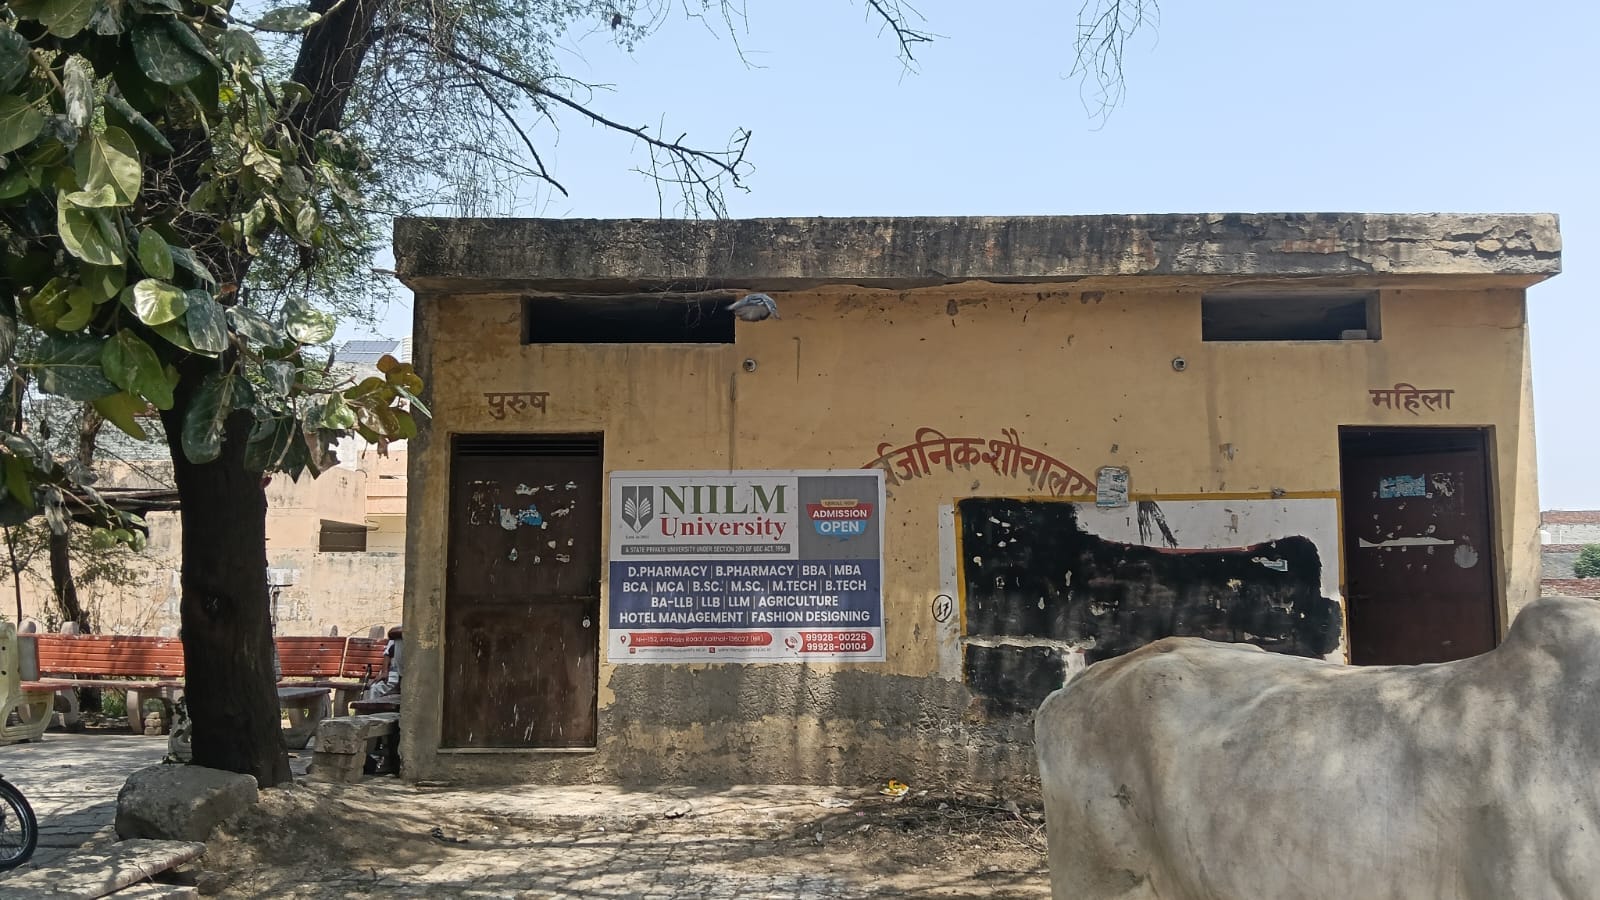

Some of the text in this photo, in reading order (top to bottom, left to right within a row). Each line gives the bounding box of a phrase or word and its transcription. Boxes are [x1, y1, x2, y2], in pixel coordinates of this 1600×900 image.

[483, 392, 550, 420] पुरुष
[1368, 383, 1455, 416] महिला
[982, 427, 1097, 498] शौचालय
[659, 485, 789, 515] NIILM
[812, 509, 868, 518] ADMISSION
[660, 516, 787, 540] University
[820, 520, 860, 533] OPEN
[628, 565, 862, 577] D.PHARMACY B.PHARMACY BBA MBA
[623, 580, 867, 593] BCA MCA B.SC. M.SC. M.TECH B.TECH
[651, 595, 839, 608] BA-LLB LLB LLM AGRICULTURE
[619, 610, 871, 623] HOTEL MANAGEMENT FASHION DESIGNING
[806, 633, 867, 641] 99928-00226
[806, 643, 867, 651] 99928-00104
